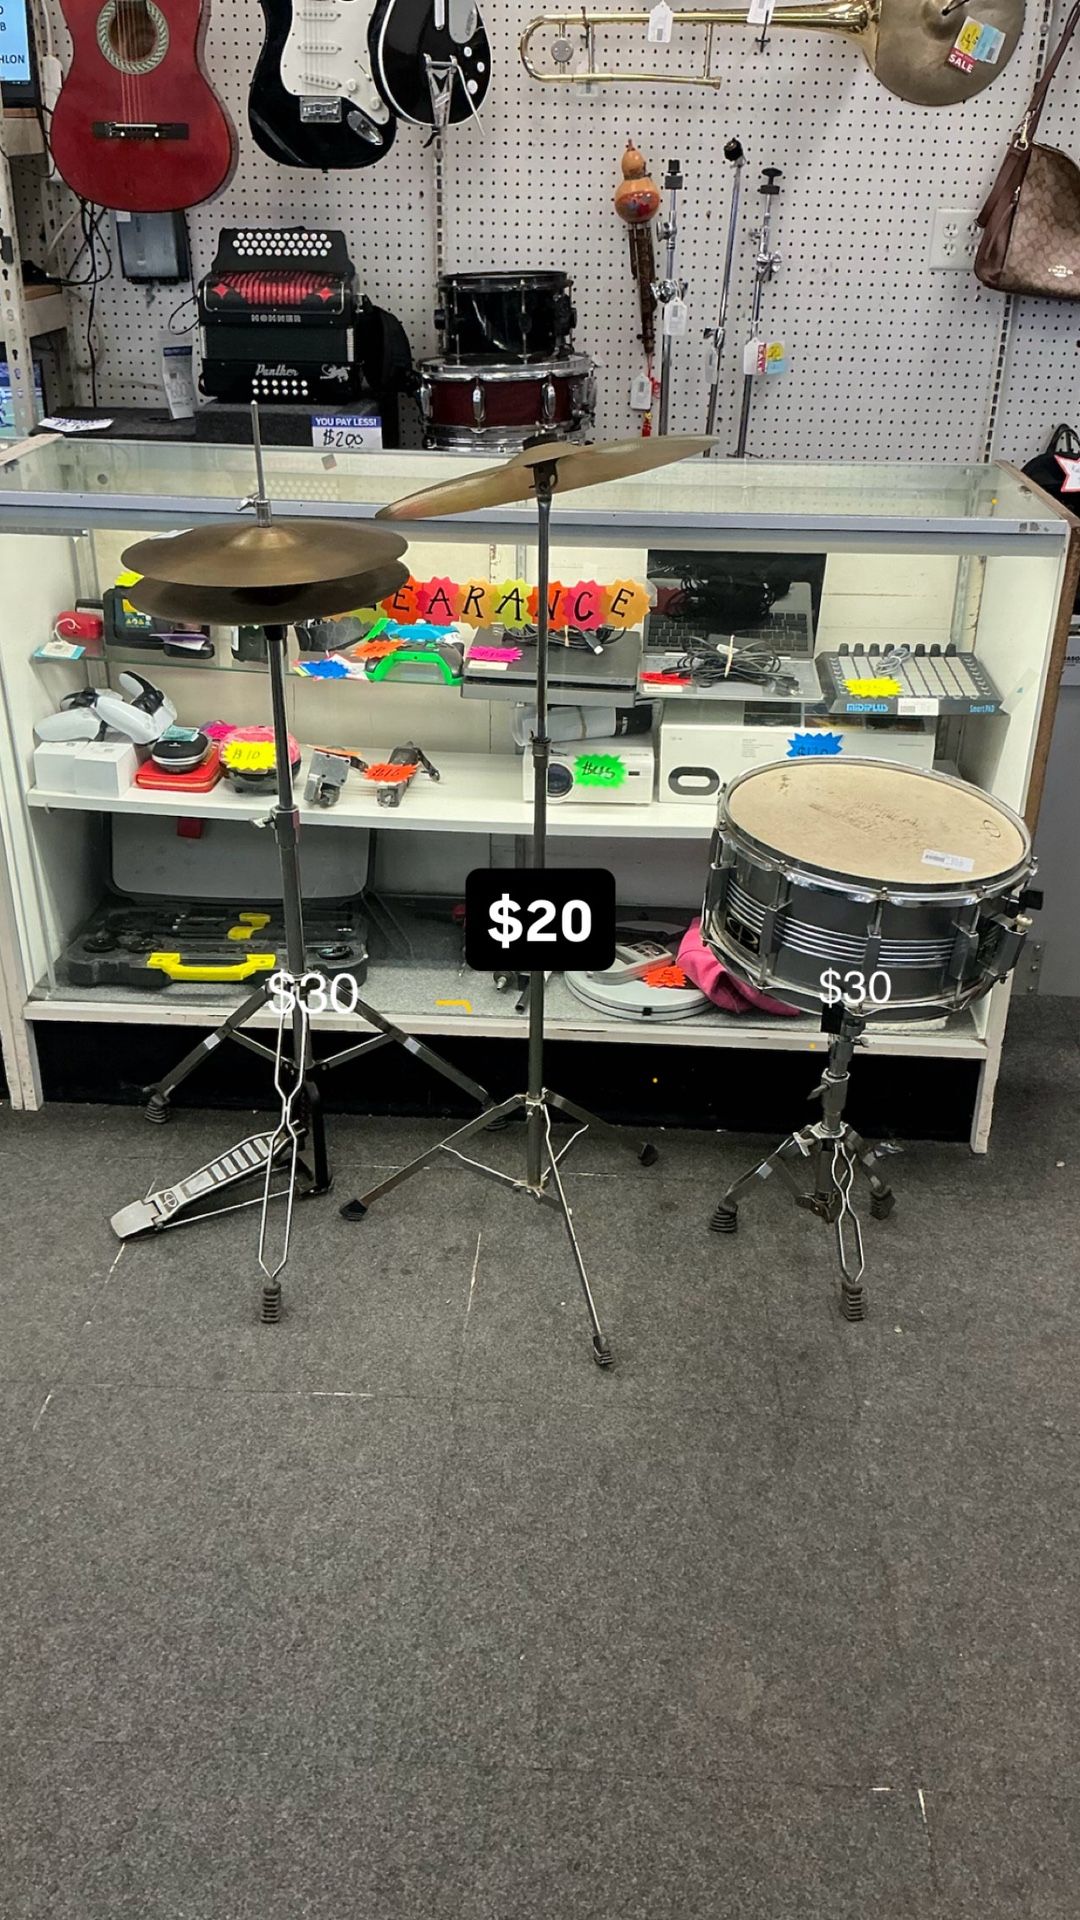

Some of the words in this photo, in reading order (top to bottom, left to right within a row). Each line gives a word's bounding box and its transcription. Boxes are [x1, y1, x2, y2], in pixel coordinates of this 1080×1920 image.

[948, 54, 974, 73] SALE
[255, 363, 299, 377] Panther
[315, 417, 334, 426] YOU
[335, 417, 352, 426] PAY
[353, 417, 377, 427] LESS!
[323, 428, 363, 448] $200
